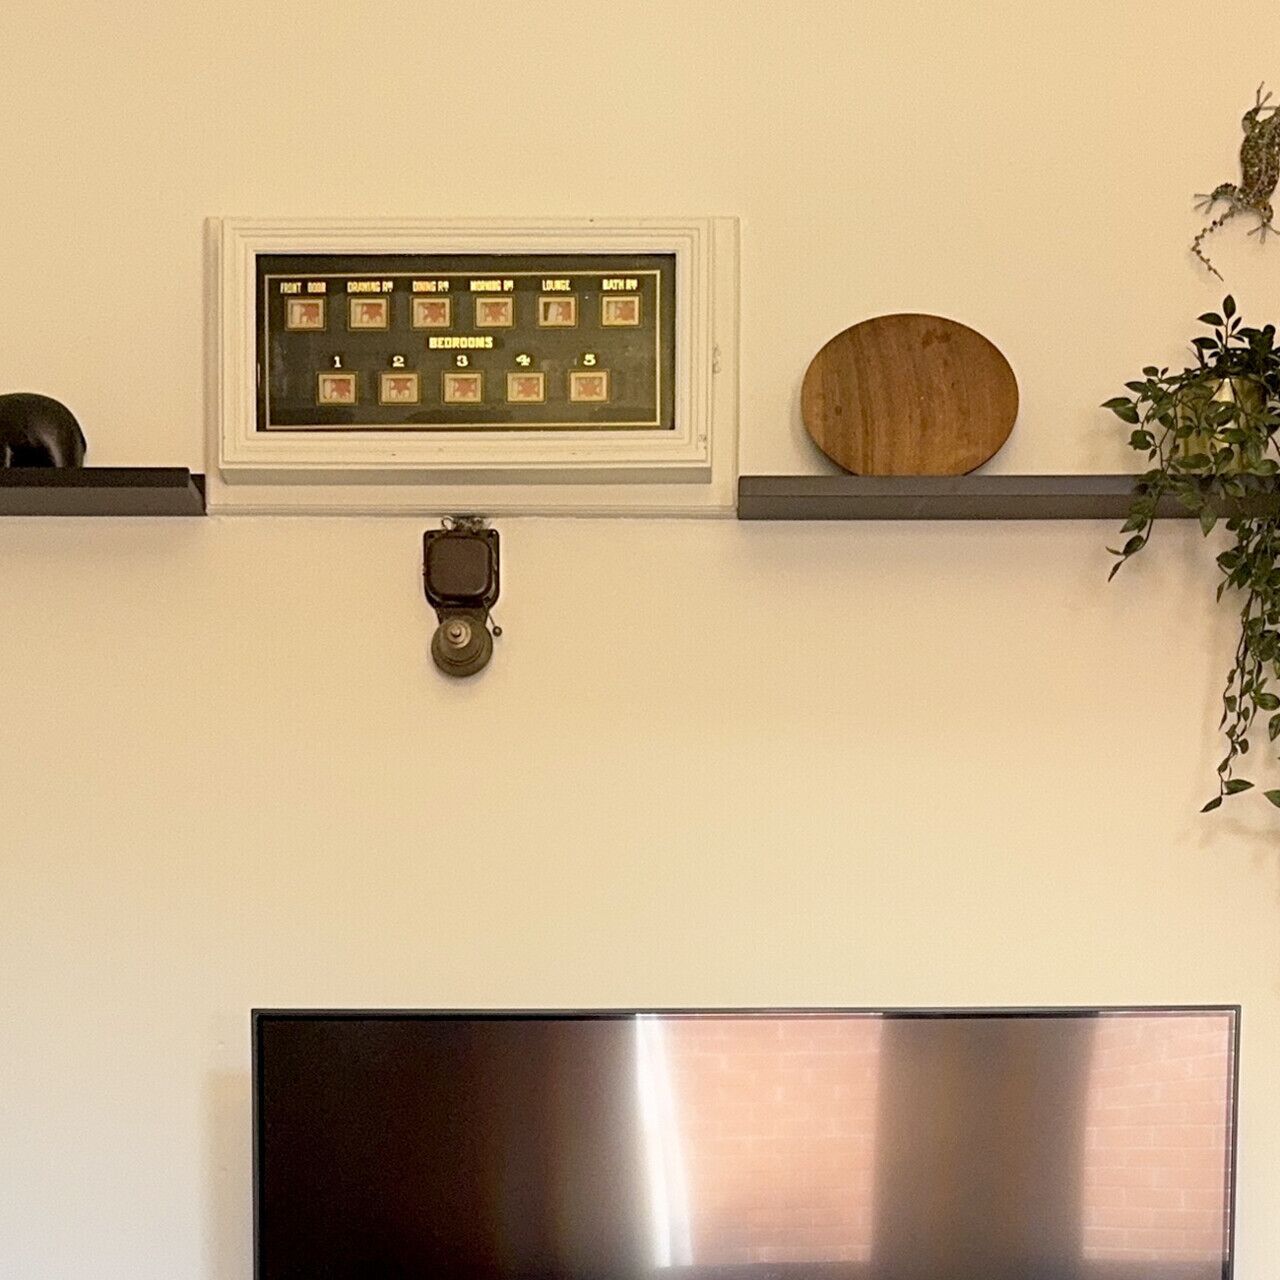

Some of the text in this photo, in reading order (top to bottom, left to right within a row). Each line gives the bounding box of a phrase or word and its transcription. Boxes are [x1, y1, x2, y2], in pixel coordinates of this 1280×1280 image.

[307, 281, 327, 293] DOOR
[542, 280, 571, 291] LOUNGE
[602, 279, 624, 290] BATH
[428, 337, 493, 349] BEDROOMS
[333, 355, 342, 368] 1
[392, 355, 405, 367] 2
[456, 355, 469, 367] 3
[515, 354, 531, 366] 4
[583, 353, 596, 366] 5
